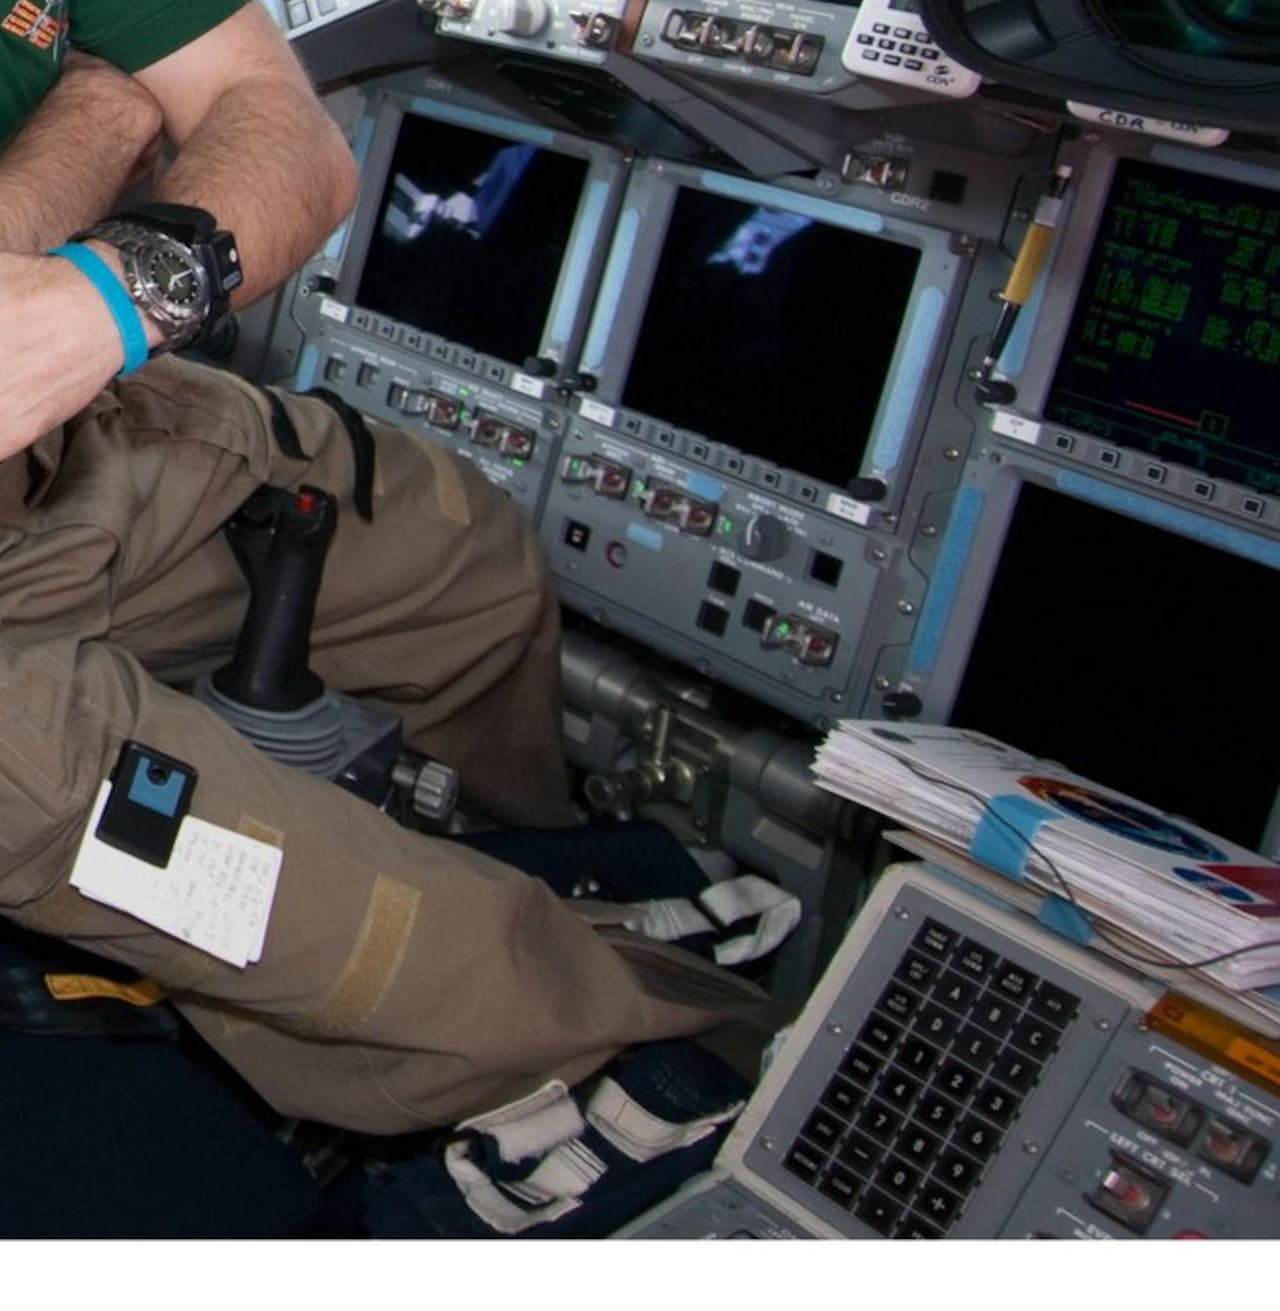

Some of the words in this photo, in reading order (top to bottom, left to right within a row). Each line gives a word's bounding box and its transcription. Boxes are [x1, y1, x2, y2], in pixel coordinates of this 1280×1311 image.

[1099, 110, 1145, 130] CDR
[817, 608, 840, 624] DATA
[949, 987, 961, 1000] A
[988, 1009, 1000, 1022] B
[932, 1018, 944, 1031] D
[1029, 1032, 1043, 1046] C
[970, 1041, 982, 1055] E
[914, 1051, 923, 1065] 1
[1010, 1064, 1022, 1077] F
[1164, 1062, 1202, 1087] POWER
[951, 1075, 964, 1089] 2
[1201, 1070, 1225, 1086] CRT
[894, 1083, 906, 1097] 4
[990, 1097, 1003, 1112] 3
[932, 1106, 944, 1120] 5
[876, 1115, 887, 1128] 7
[971, 1131, 983, 1145] 6
[913, 1139, 925, 1153] 8
[1109, 1133, 1139, 1153] LEFT
[1142, 1151, 1167, 1170] CRT
[1172, 1166, 1193, 1185] SEL
[952, 1164, 965, 1177] 9
[893, 1171, 905, 1185] 0
